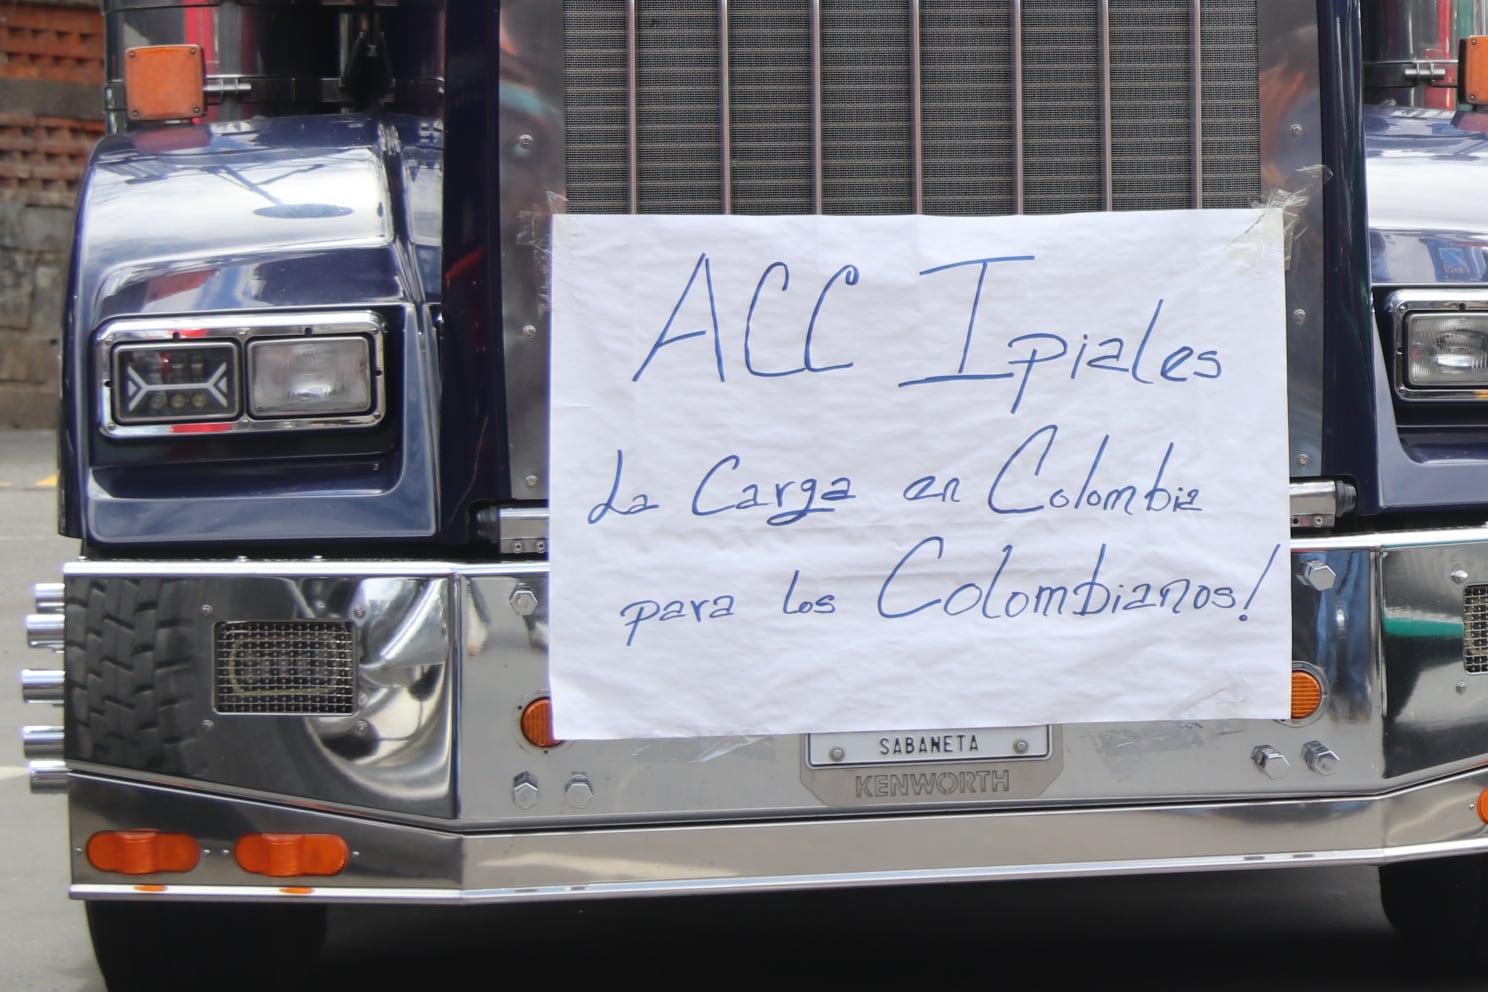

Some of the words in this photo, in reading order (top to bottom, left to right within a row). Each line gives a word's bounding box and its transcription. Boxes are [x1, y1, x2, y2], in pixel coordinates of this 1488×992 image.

[633, 253, 861, 382] ACC
[898, 255, 1223, 414] Ipiales
[587, 449, 660, 524] La
[691, 454, 857, 526] Carga
[903, 475, 961, 504] en
[987, 424, 1202, 515] Colombia
[620, 594, 736, 646] para
[782, 569, 837, 616] los
[877, 536, 1281, 622] Colombianos!
[855, 769, 1010, 798] KENWORTH
[879, 734, 979, 755] SABANETA
